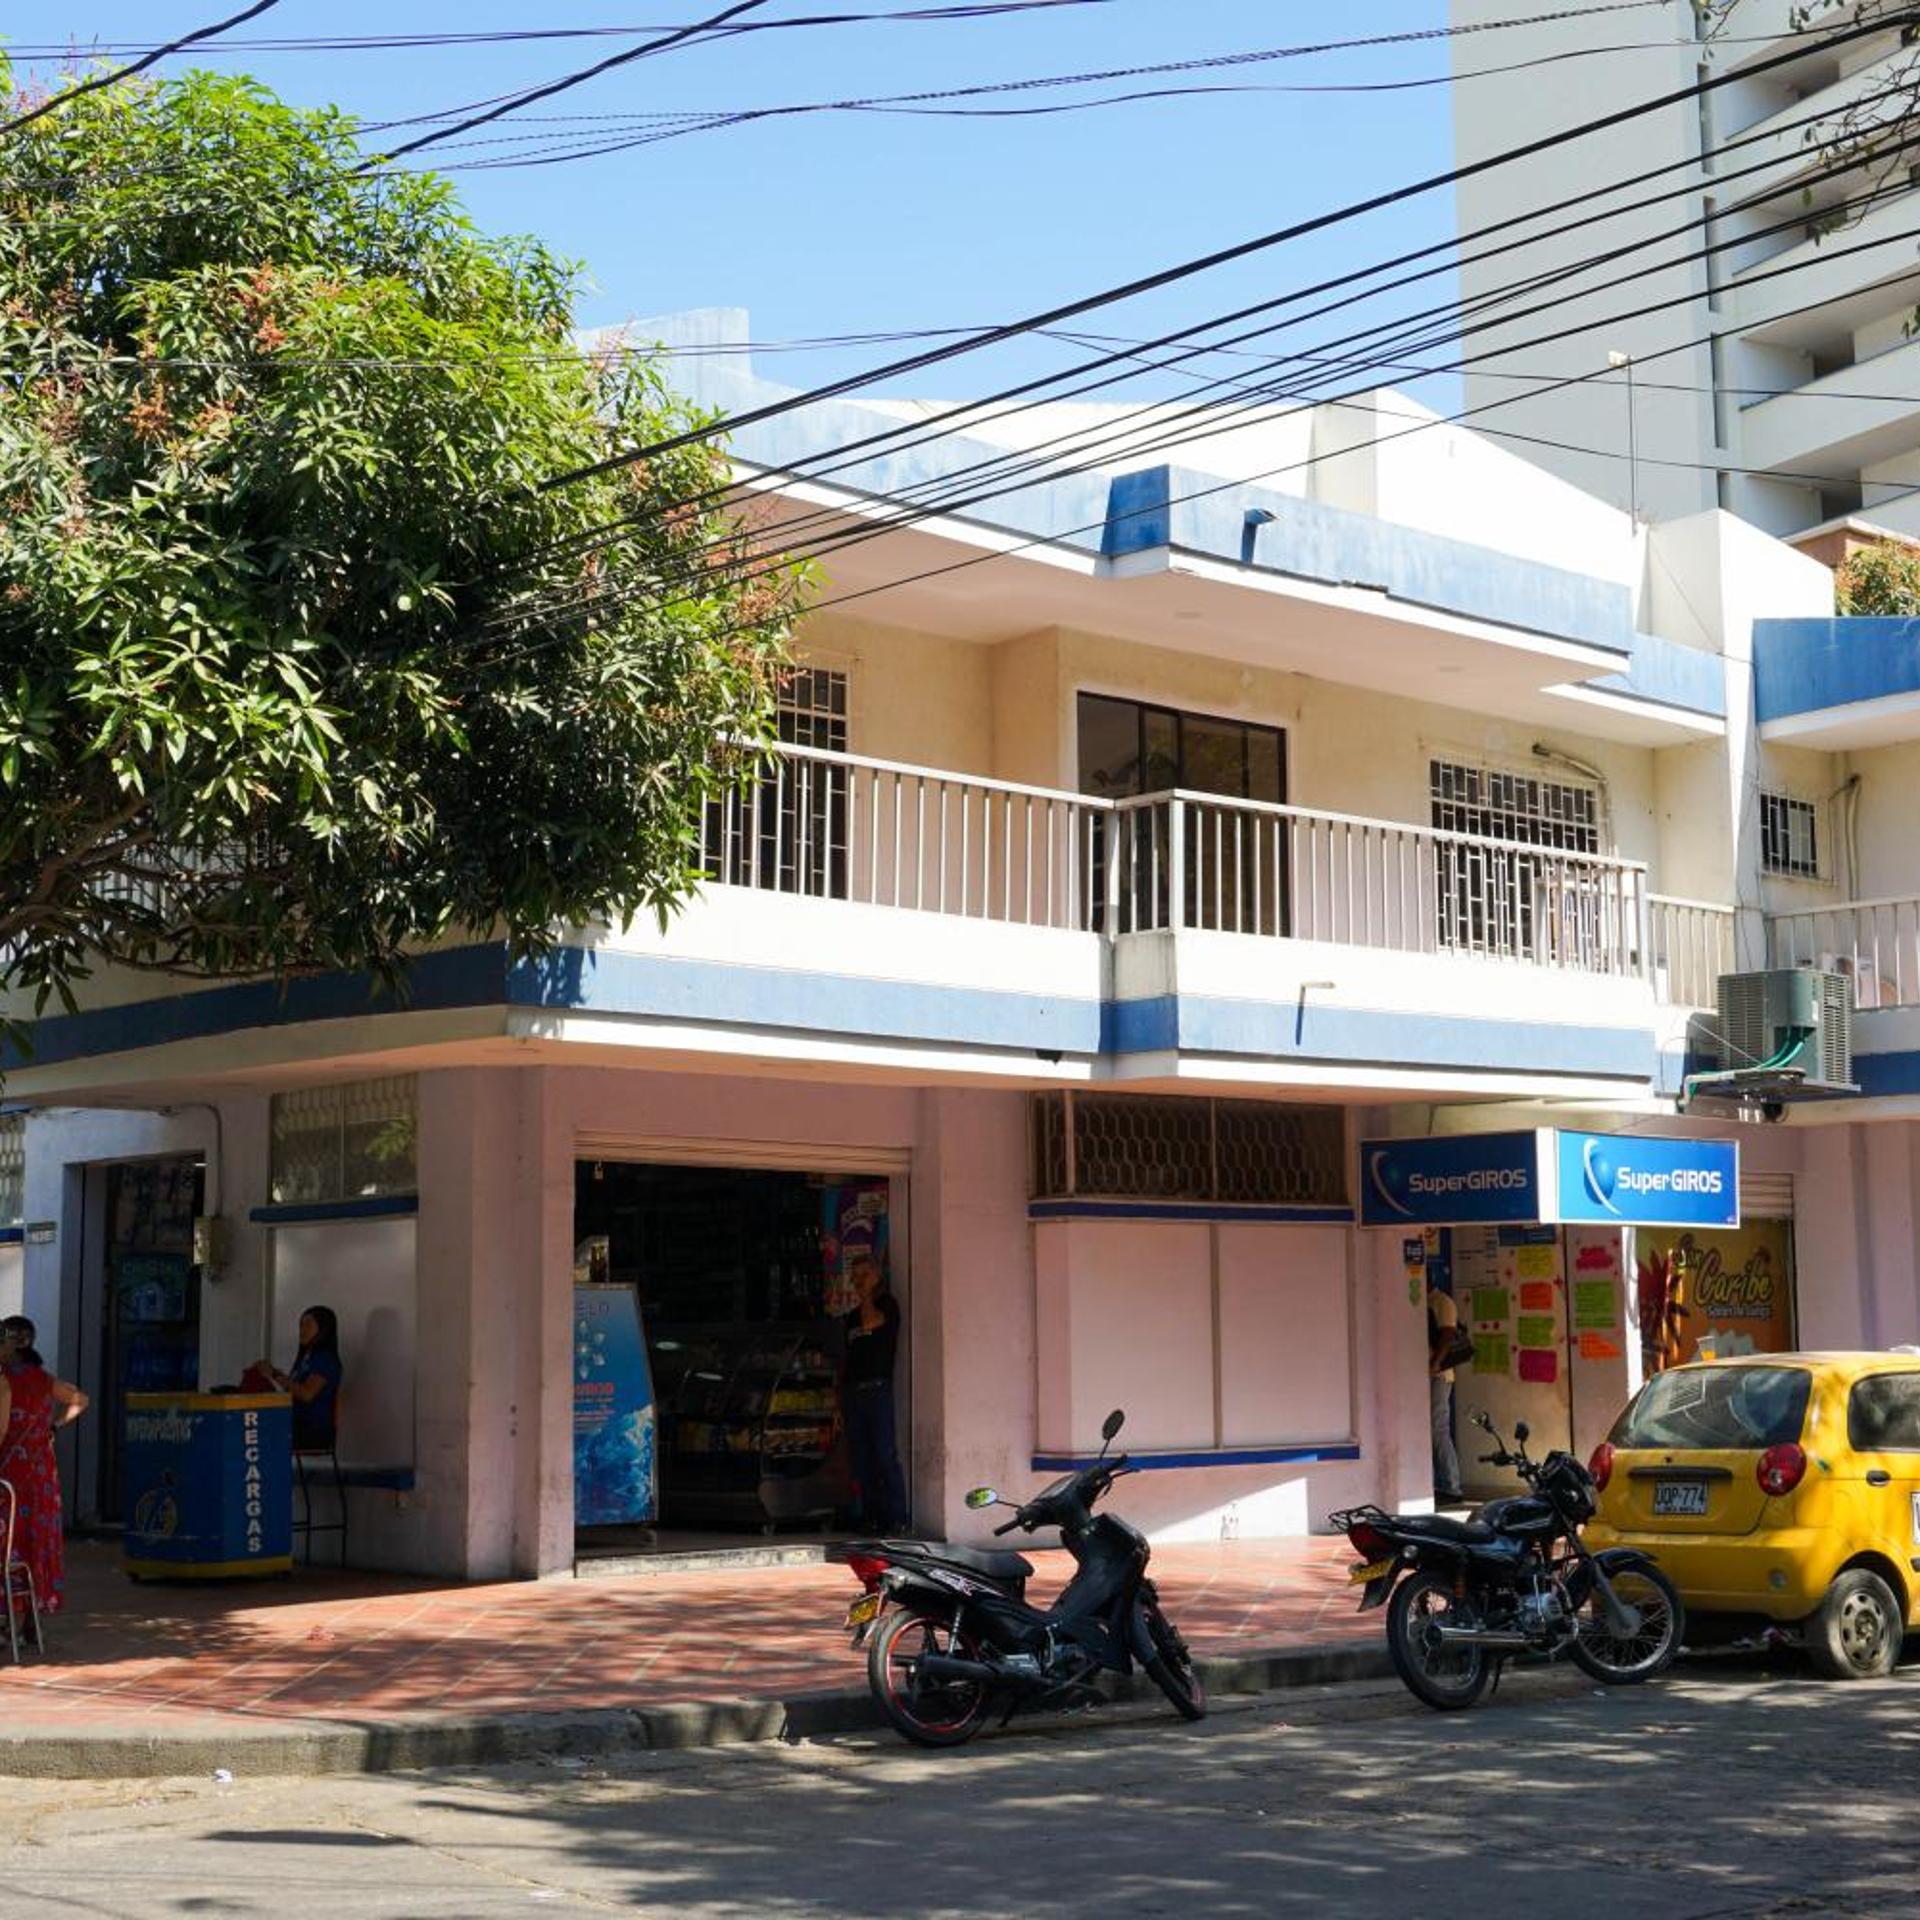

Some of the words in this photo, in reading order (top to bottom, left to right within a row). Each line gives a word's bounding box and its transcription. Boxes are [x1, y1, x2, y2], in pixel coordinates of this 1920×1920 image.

[1408, 1168, 1528, 1196] SuperGIROS
[1617, 1166, 1723, 1196] SuperGIROS
[1694, 1247, 1776, 1306] Caribe
[244, 1411, 262, 1553] RECARGAS
